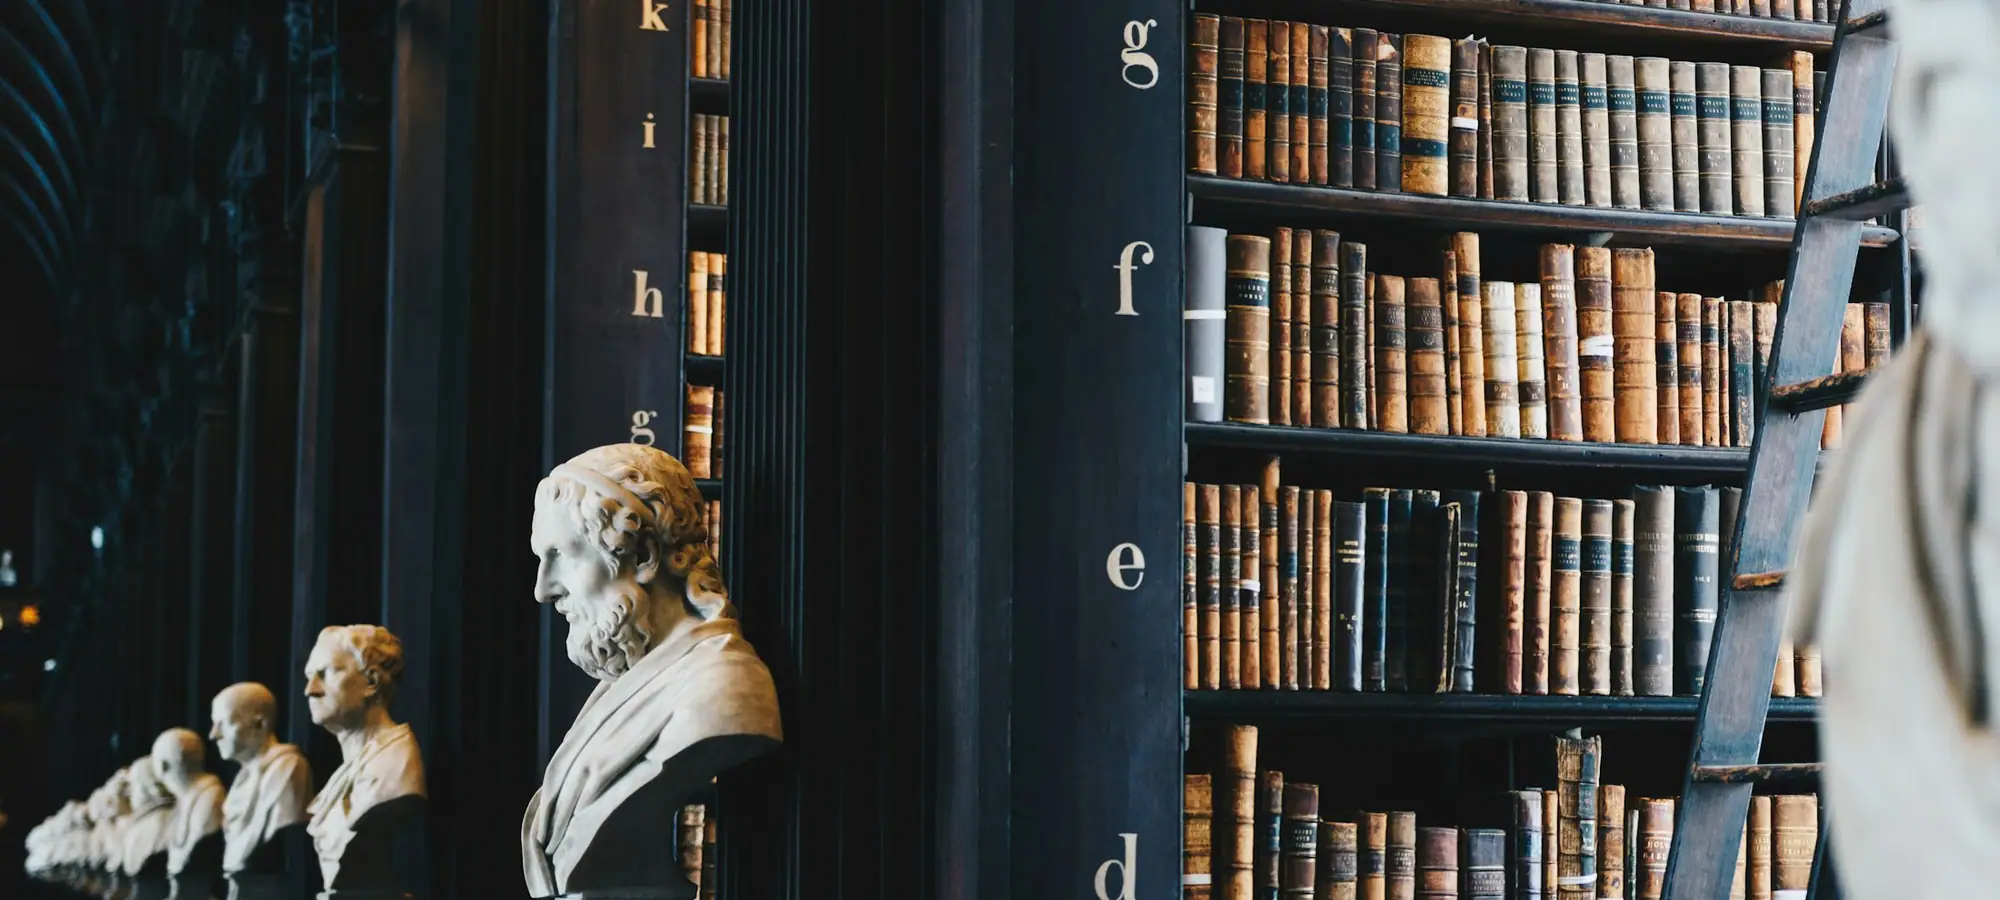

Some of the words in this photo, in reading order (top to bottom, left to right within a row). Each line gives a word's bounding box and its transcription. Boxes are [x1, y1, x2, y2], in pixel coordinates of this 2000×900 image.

[640, 0, 669, 31] k
[1121, 19, 1158, 89] g
[643, 113, 656, 148] i
[632, 270, 664, 317] h
[1114, 241, 1154, 316] f
[631, 411, 658, 446] g
[1107, 543, 1146, 590] e
[1095, 833, 1138, 900] d
